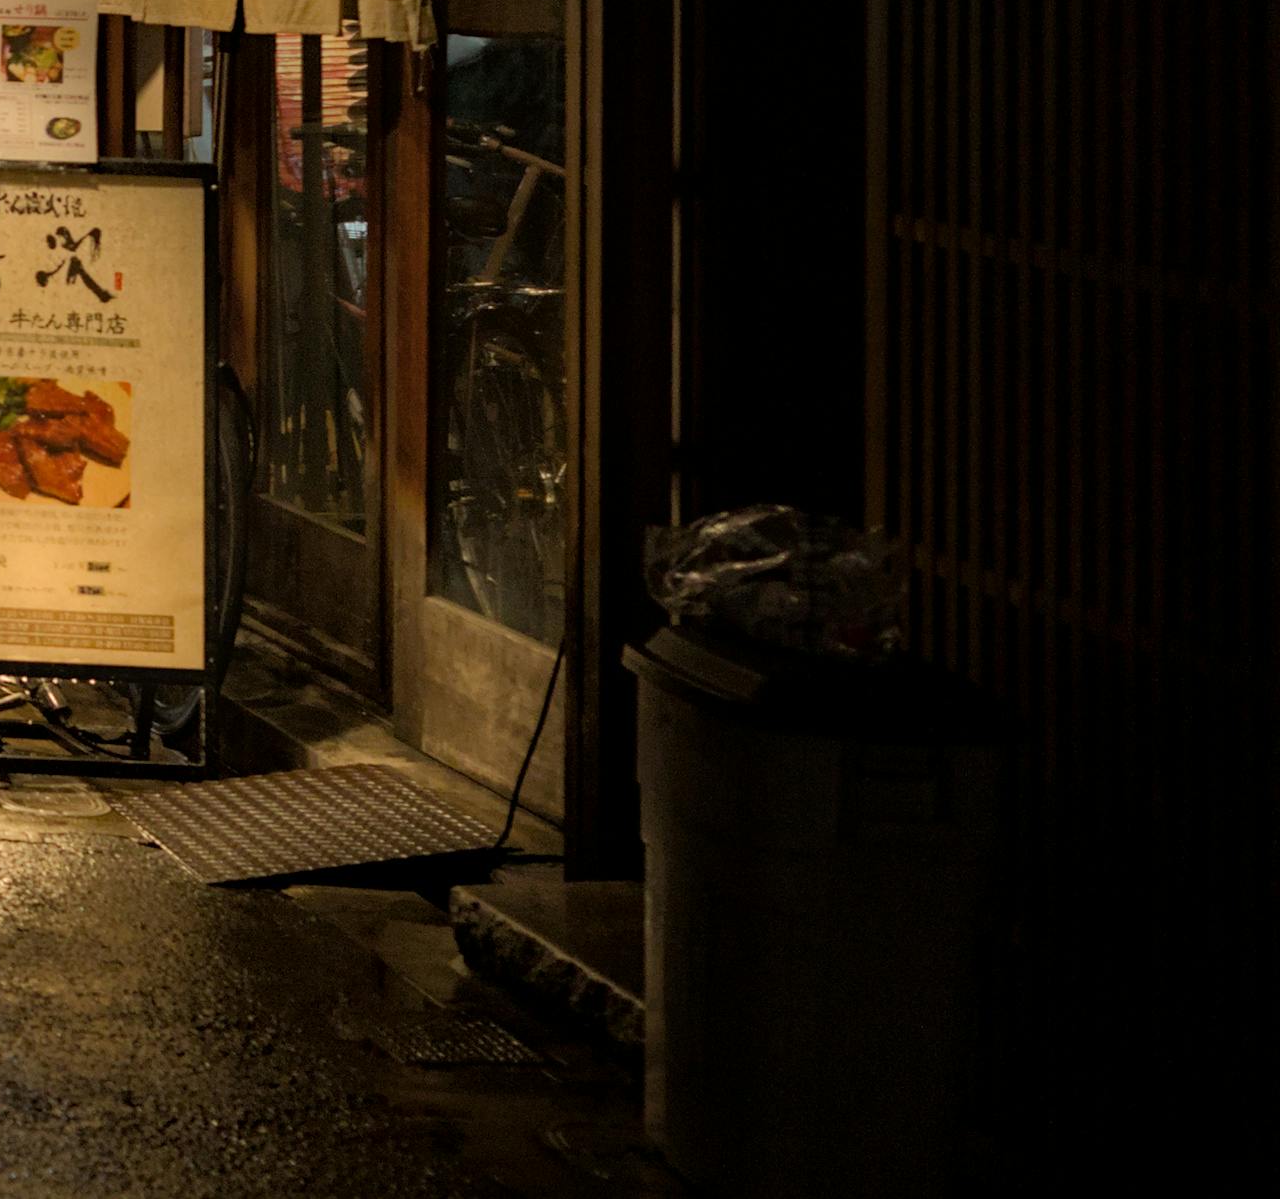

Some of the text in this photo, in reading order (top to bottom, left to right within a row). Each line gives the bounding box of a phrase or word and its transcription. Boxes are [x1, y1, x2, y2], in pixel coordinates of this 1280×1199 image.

[9, 308, 127, 335] 牛たん専門店
